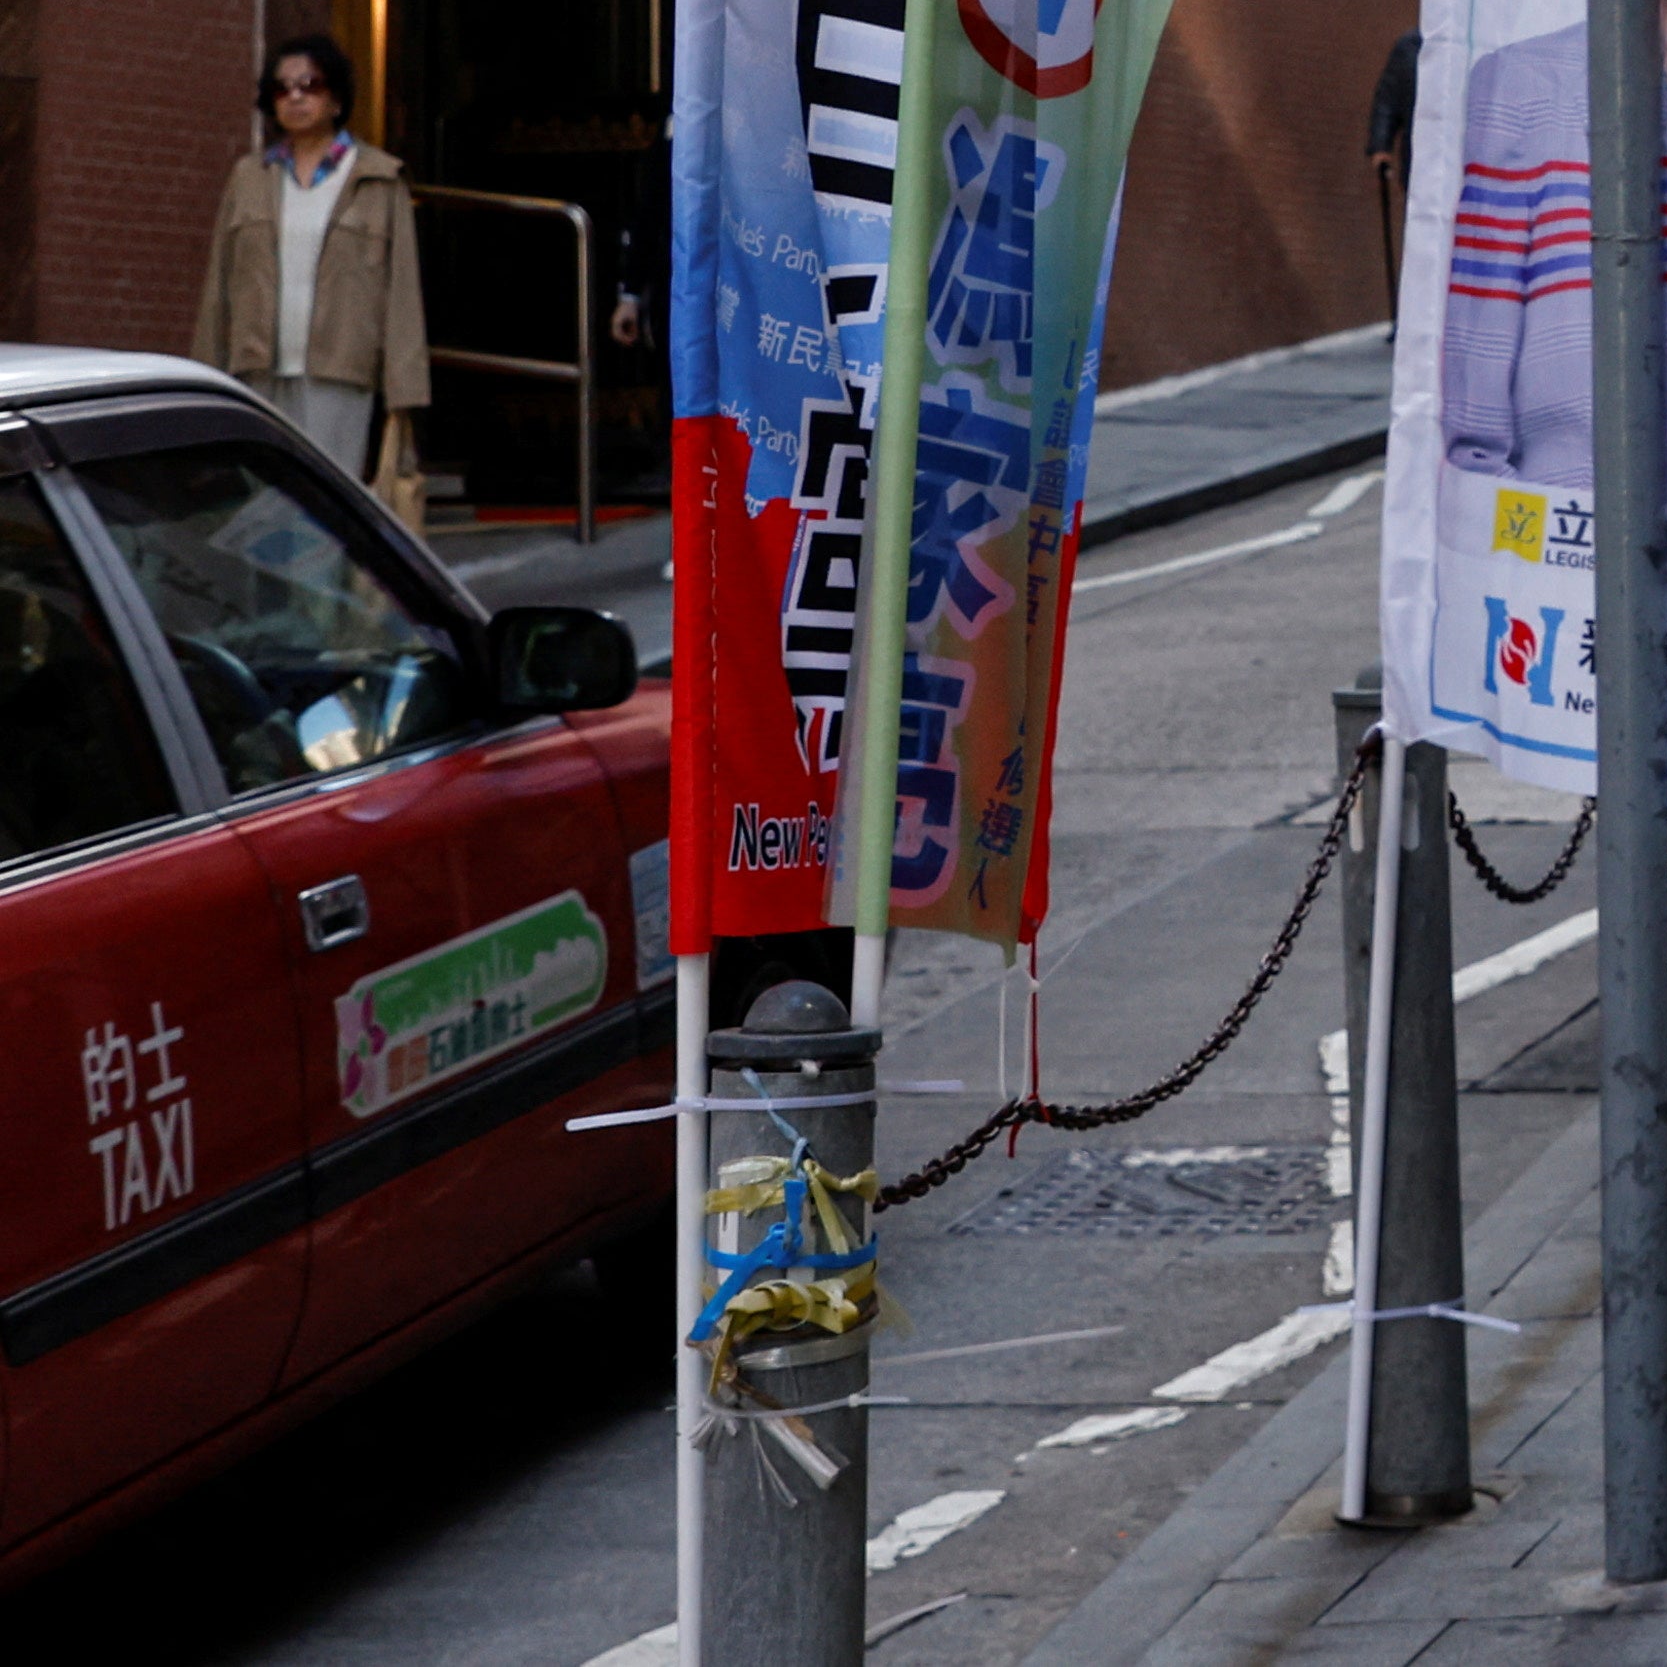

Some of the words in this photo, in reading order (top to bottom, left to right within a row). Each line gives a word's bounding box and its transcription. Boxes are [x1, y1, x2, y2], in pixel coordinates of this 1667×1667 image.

[1565, 691, 1596, 714] Ne
[729, 803, 802, 871] New
[81, 1000, 187, 1125] 的士
[89, 1098, 195, 1230] TAXI
